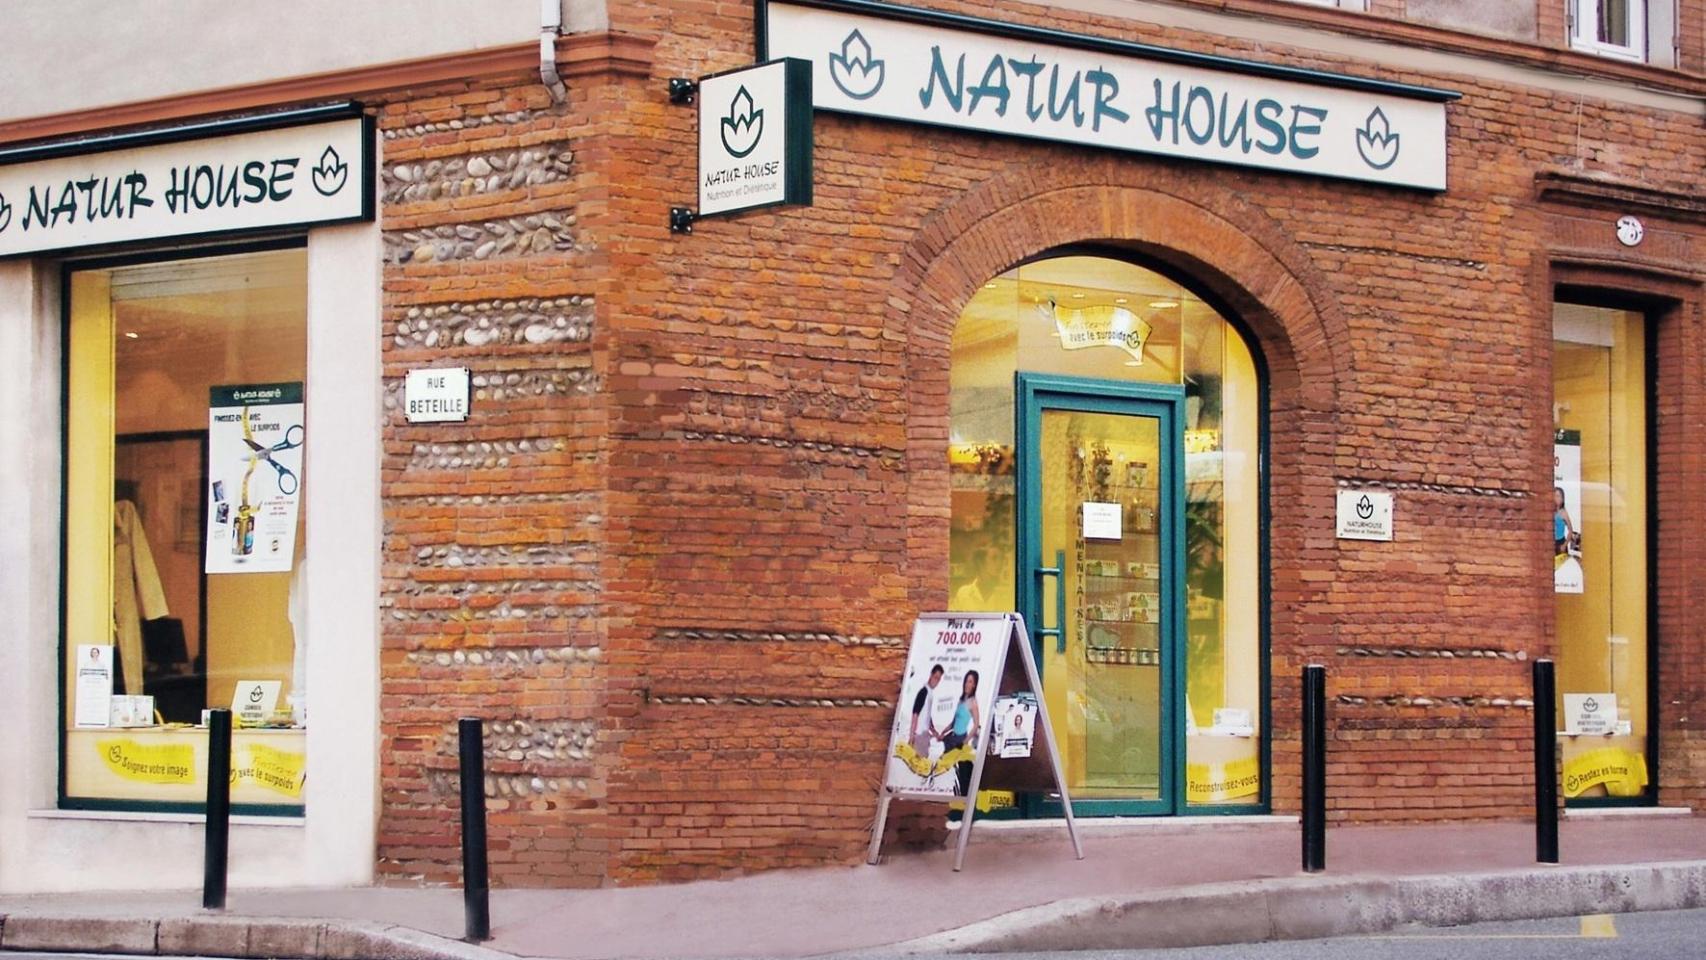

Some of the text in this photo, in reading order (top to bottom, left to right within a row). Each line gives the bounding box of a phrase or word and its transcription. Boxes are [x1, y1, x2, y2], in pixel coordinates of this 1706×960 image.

[918, 43, 1329, 160] NATUR HOUSE
[705, 160, 779, 187] NATUR HOUSE
[22, 157, 300, 231] NATUR HOUSE
[1087, 330, 1095, 341] le
[1096, 330, 1127, 342] surpoids
[410, 377, 463, 414] RUE BETEILLE
[947, 618, 975, 629] Plus de
[936, 631, 982, 645] 700.000
[122, 756, 188, 778] Soignez votre image
[1578, 769, 1600, 784] Restez
[238, 767, 294, 790] avec le surpoids
[1189, 774, 1258, 793] Reconstruisez-vous
